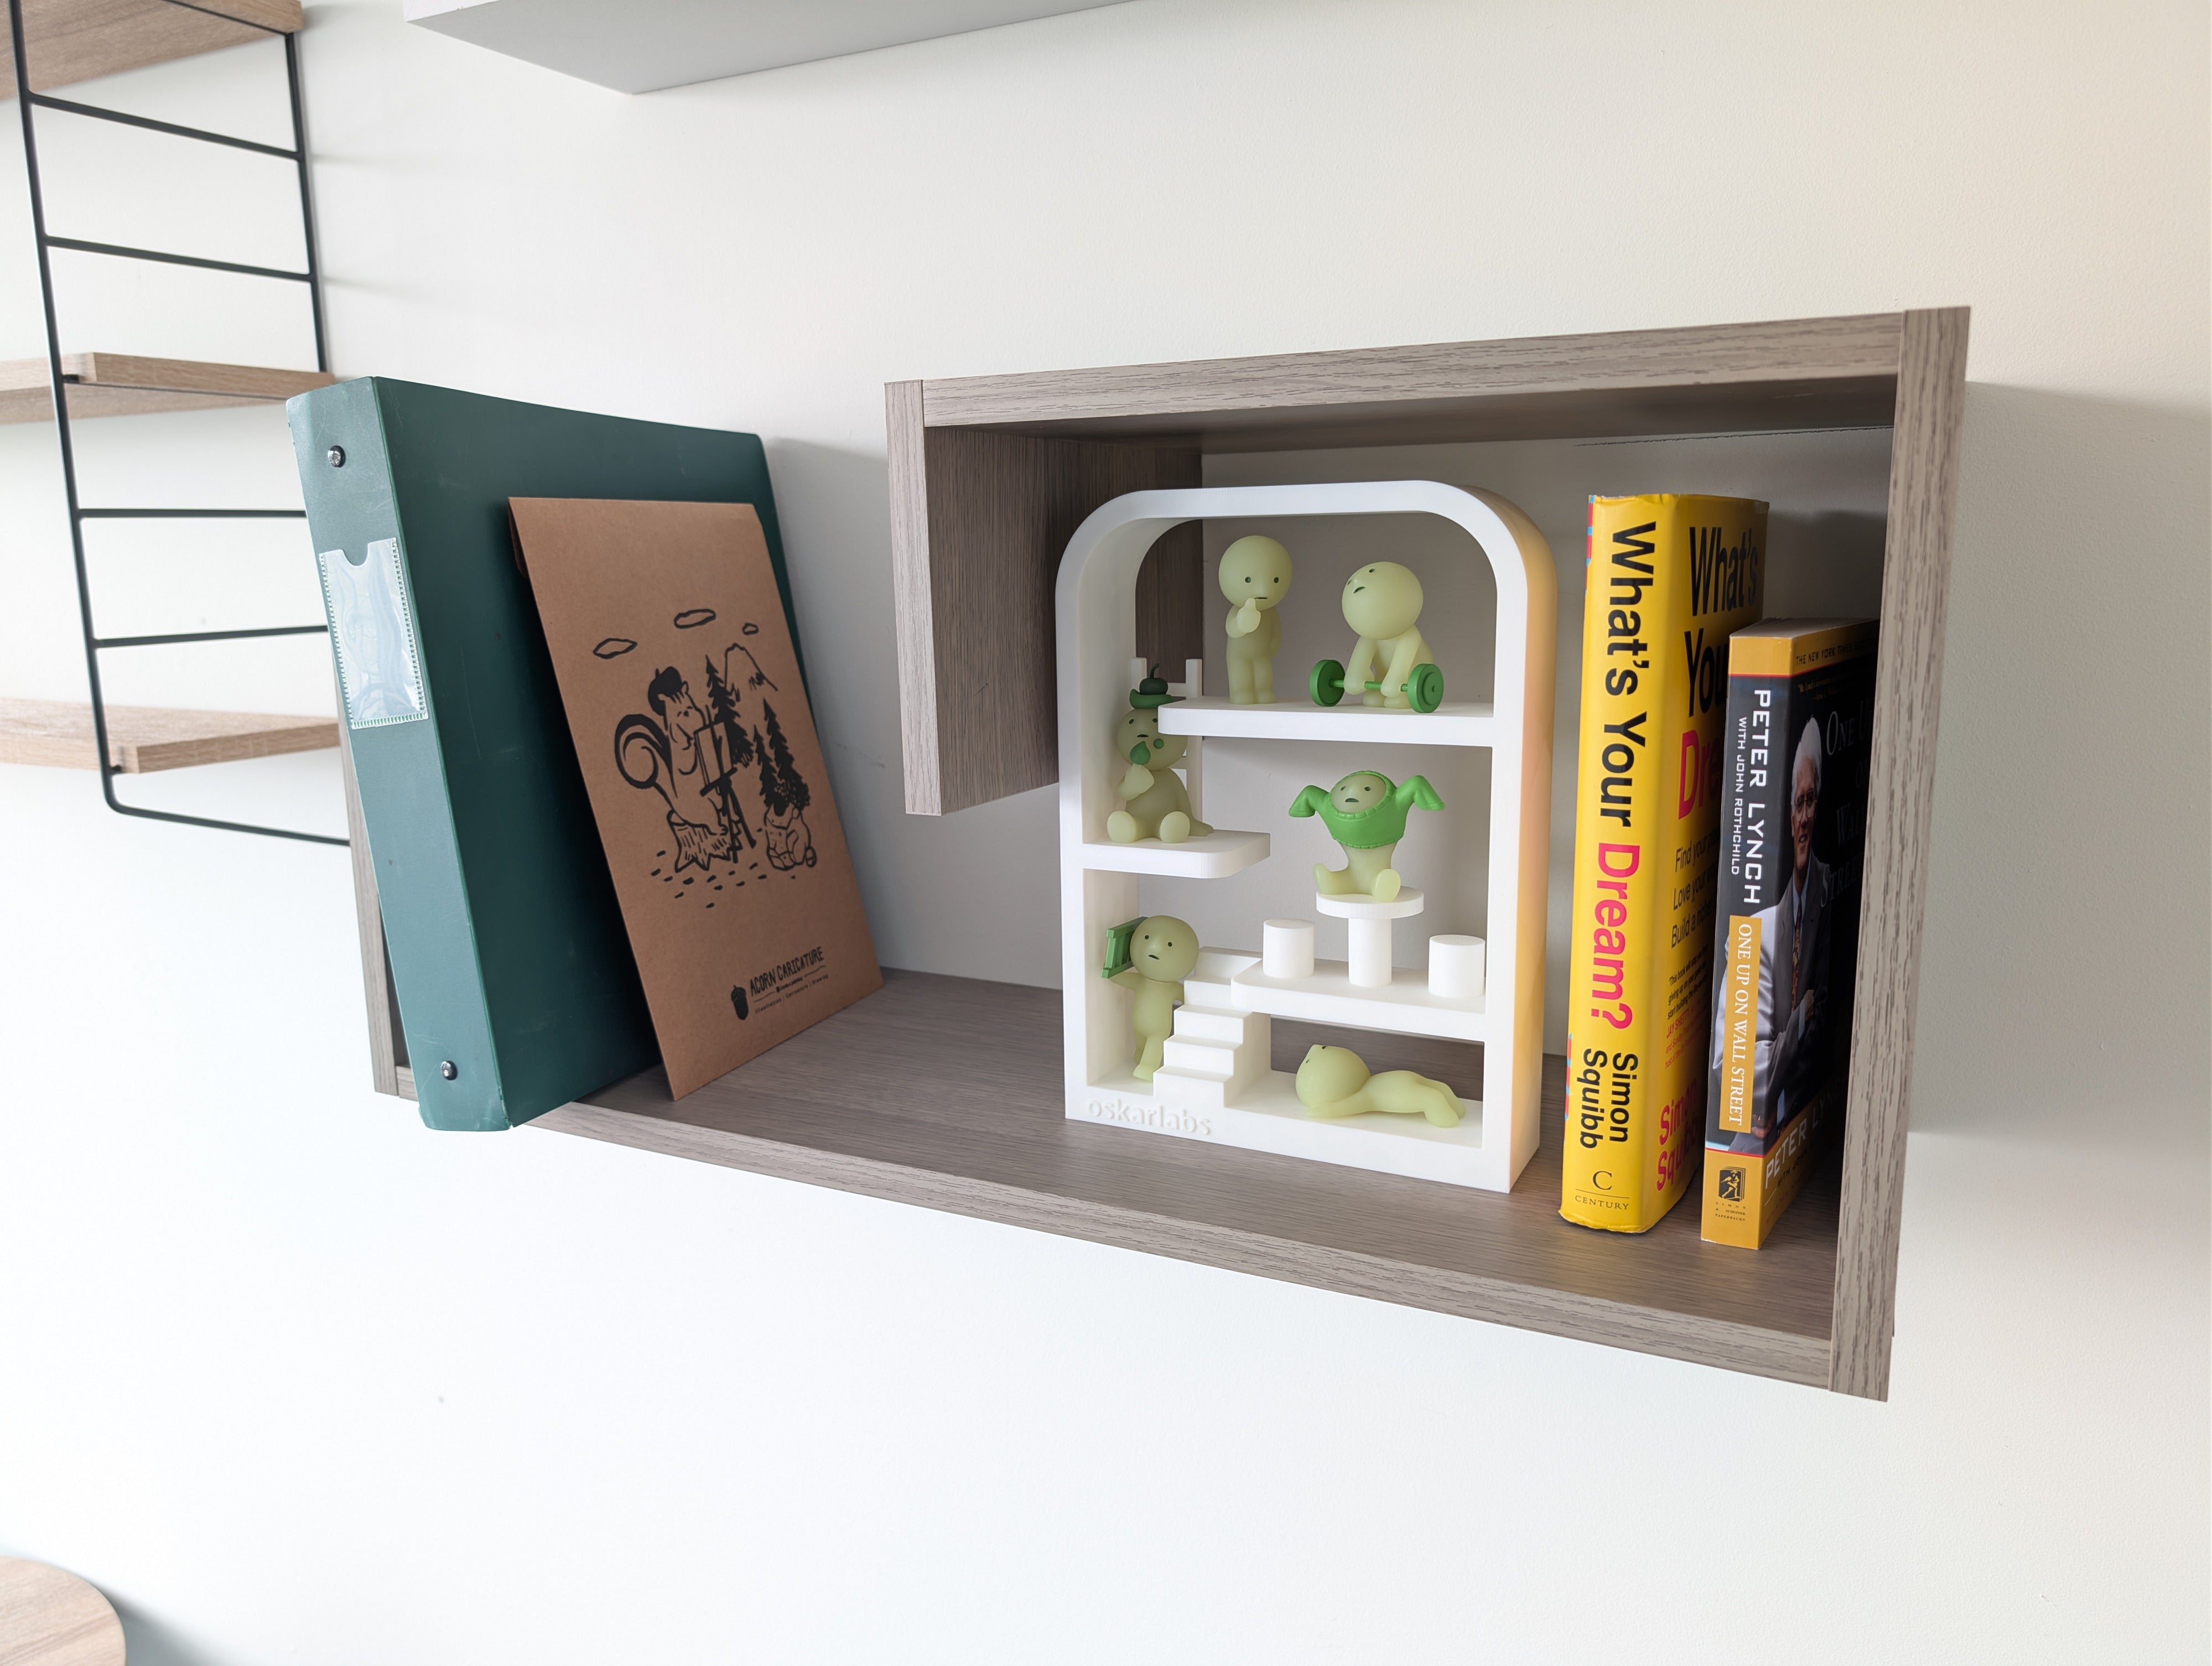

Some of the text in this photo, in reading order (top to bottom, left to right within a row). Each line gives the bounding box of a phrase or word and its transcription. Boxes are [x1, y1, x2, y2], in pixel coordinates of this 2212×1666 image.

[1689, 526, 1758, 616] What's
[1684, 627, 1728, 718] You
[1796, 654, 1806, 666] THE
[1808, 651, 1819, 662] NEW
[1821, 646, 1836, 659] YORK
[1837, 642, 1852, 655] TIMES
[1826, 711, 1855, 756] ONE
[1591, 521, 1657, 1029] What's Your Dream?
[1678, 729, 1722, 820] Dre
[1731, 717, 1747, 875] WITH JOHN ROTHCHILD
[1743, 689, 1771, 904] PETER LYNCH
[1675, 840, 1692, 873] Find
[1692, 834, 1707, 868] your
[1673, 881, 1691, 911] Love
[1691, 870, 1706, 904] your
[1671, 912, 1690, 949] Build
[1691, 914, 1696, 932] a
[750, 968, 776, 997] ACORN
[777, 946, 824, 981] CARICATURE
[1728, 923, 1752, 1128] ONE UP ON WALL STREET
[1088, 1098, 1211, 1135] oskarlabs
[1576, 1048, 1607, 1149] Squibb
[1608, 1052, 1639, 1143] Simon
[1659, 1078, 1697, 1145] Simon
[1592, 1170, 1613, 1191] C
[1765, 1117, 1808, 1190] PETER
[1575, 1195, 1629, 1211] CENTURY
